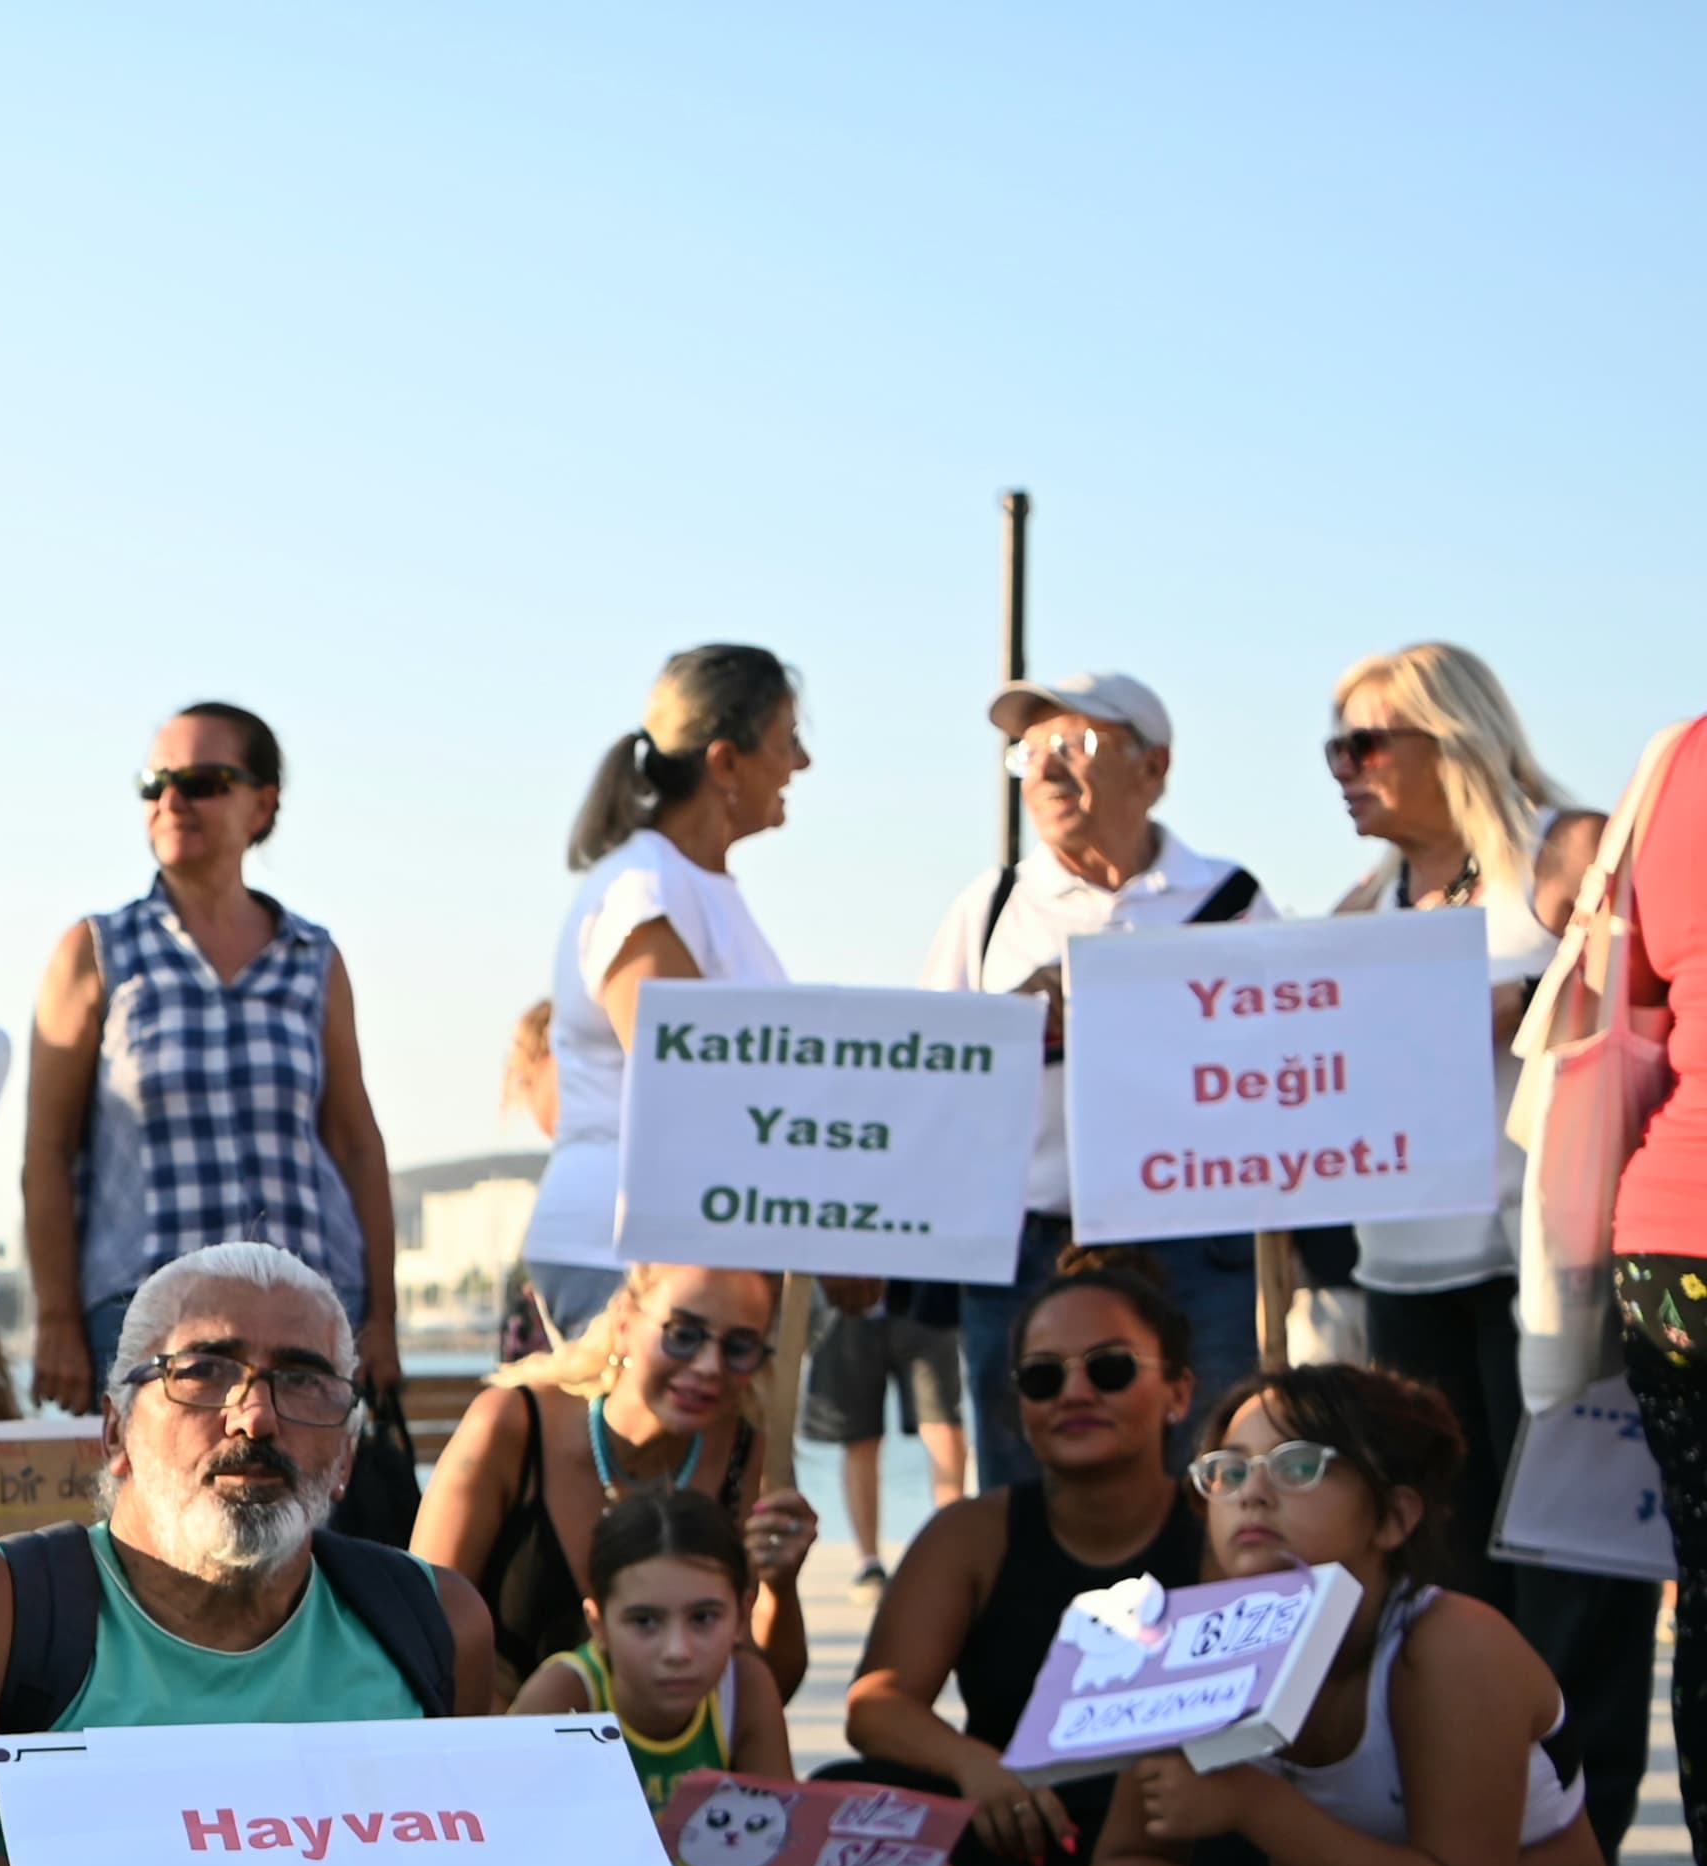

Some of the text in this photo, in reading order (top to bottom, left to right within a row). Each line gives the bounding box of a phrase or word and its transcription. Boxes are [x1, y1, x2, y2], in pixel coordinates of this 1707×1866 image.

[1187, 976, 1342, 1019] Yasa
[653, 1021, 995, 1075] Katliamdan
[1192, 1052, 1347, 1107] Değil
[746, 1104, 892, 1152] Yasa
[1140, 1131, 1410, 1193] Cinayet.!
[699, 1184, 933, 1236] Olmaz...
[181, 1805, 487, 1862] Hayvan
